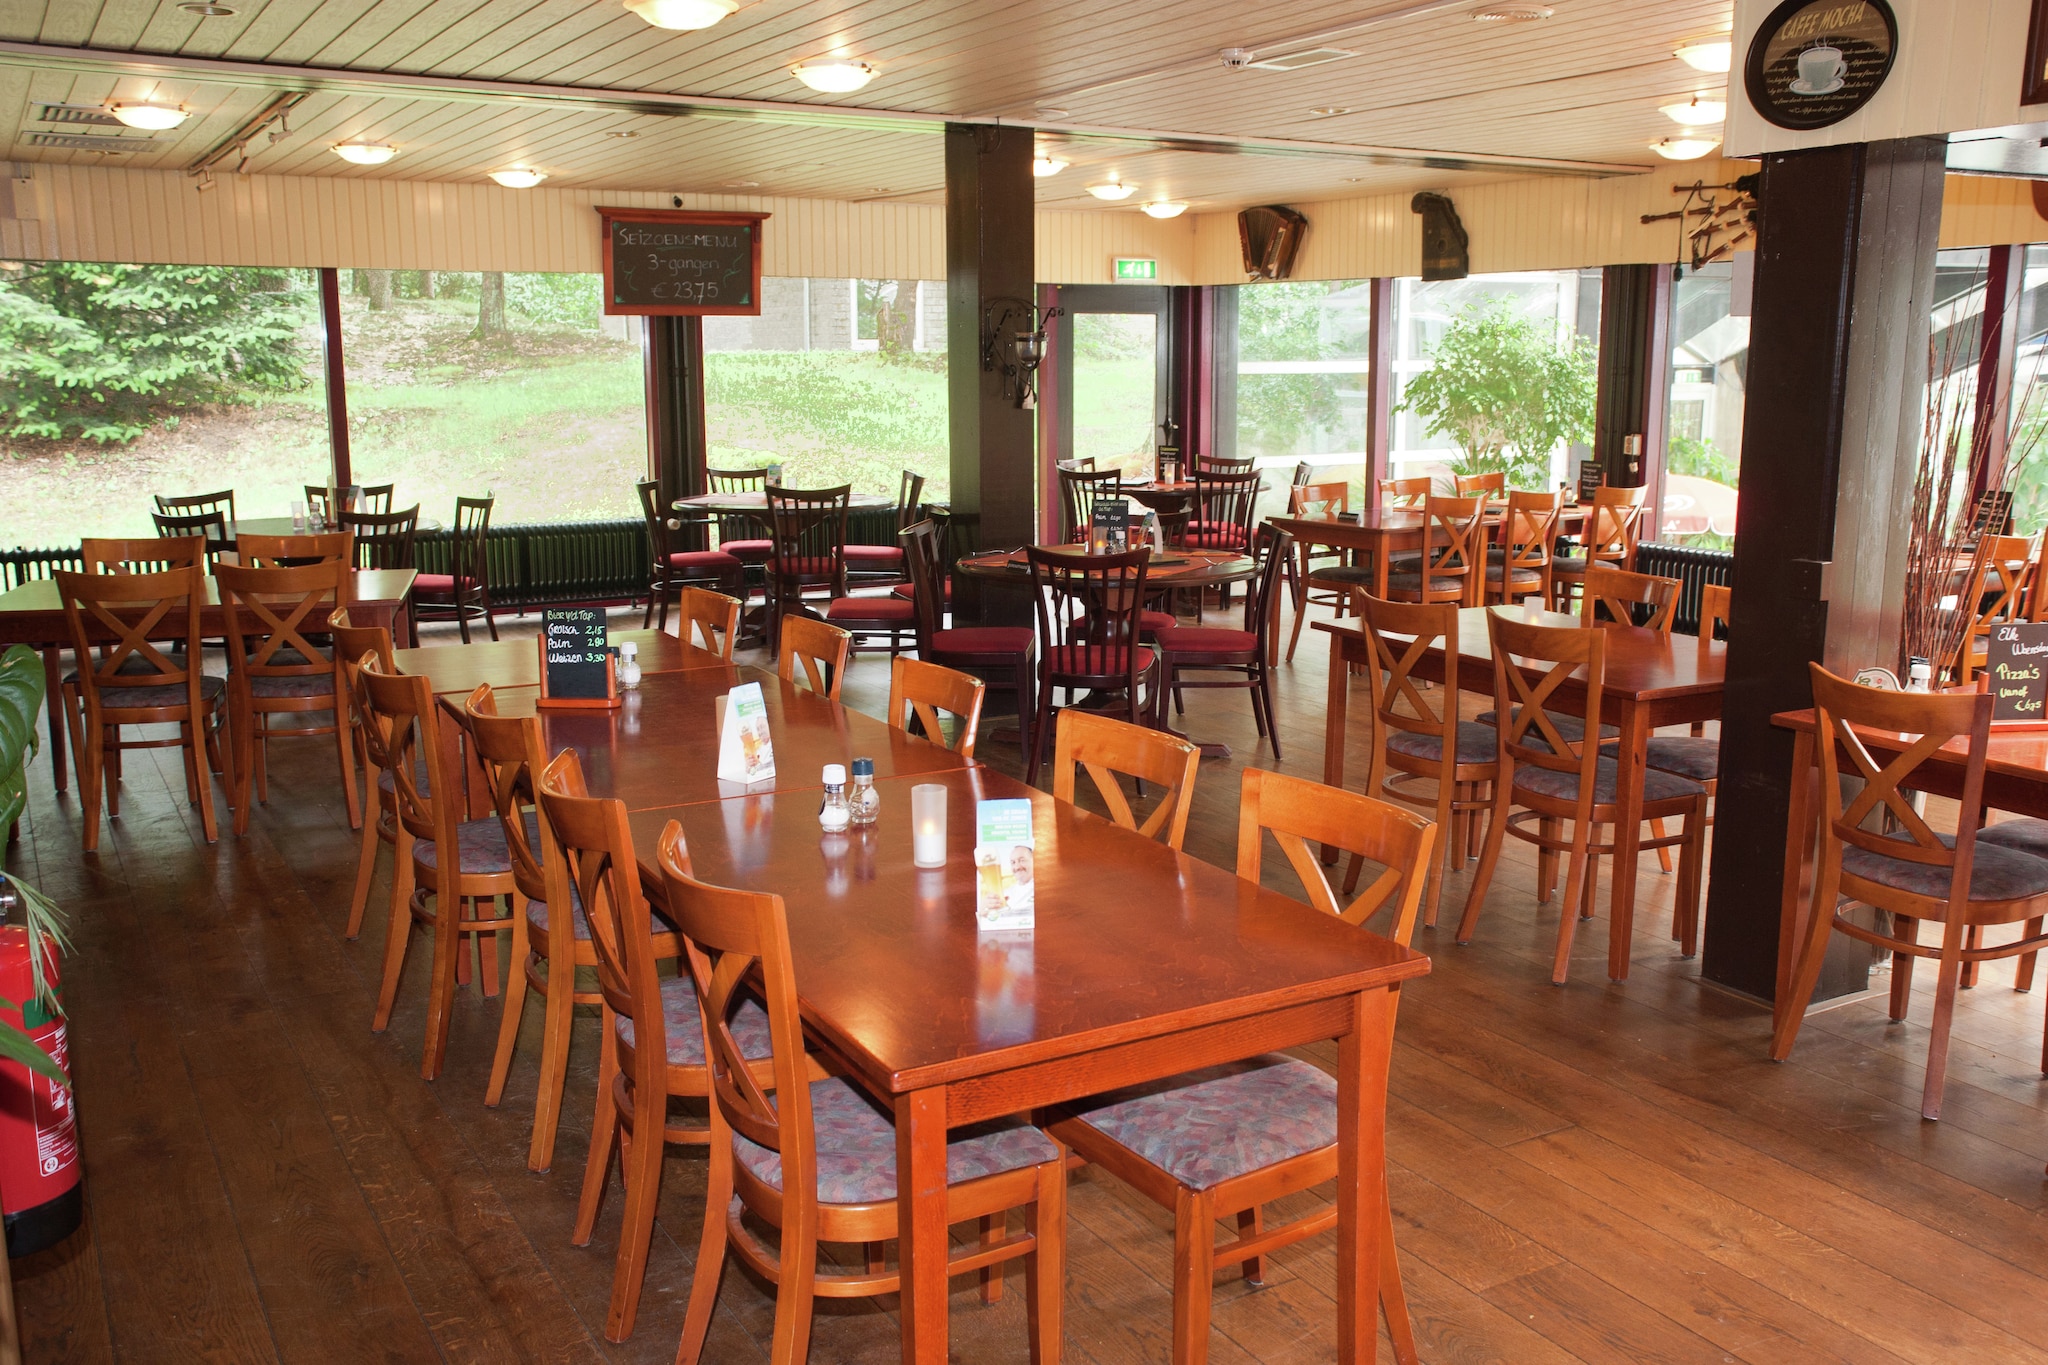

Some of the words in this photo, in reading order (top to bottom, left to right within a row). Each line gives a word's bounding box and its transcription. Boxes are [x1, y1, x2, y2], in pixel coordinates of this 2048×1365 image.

[1781, 12, 1819, 41] CAFFE
[1818, 1, 1867, 32] MOCHA
[647, 253, 720, 277] 3-gangen
[673, 281, 719, 304] 23,75
[584, 625, 606, 636] 2,15
[547, 638, 573, 650] Palm
[548, 653, 582, 664] Weizen
[585, 652, 606, 663] 3,30
[1995, 662, 2041, 680] Pizza's
